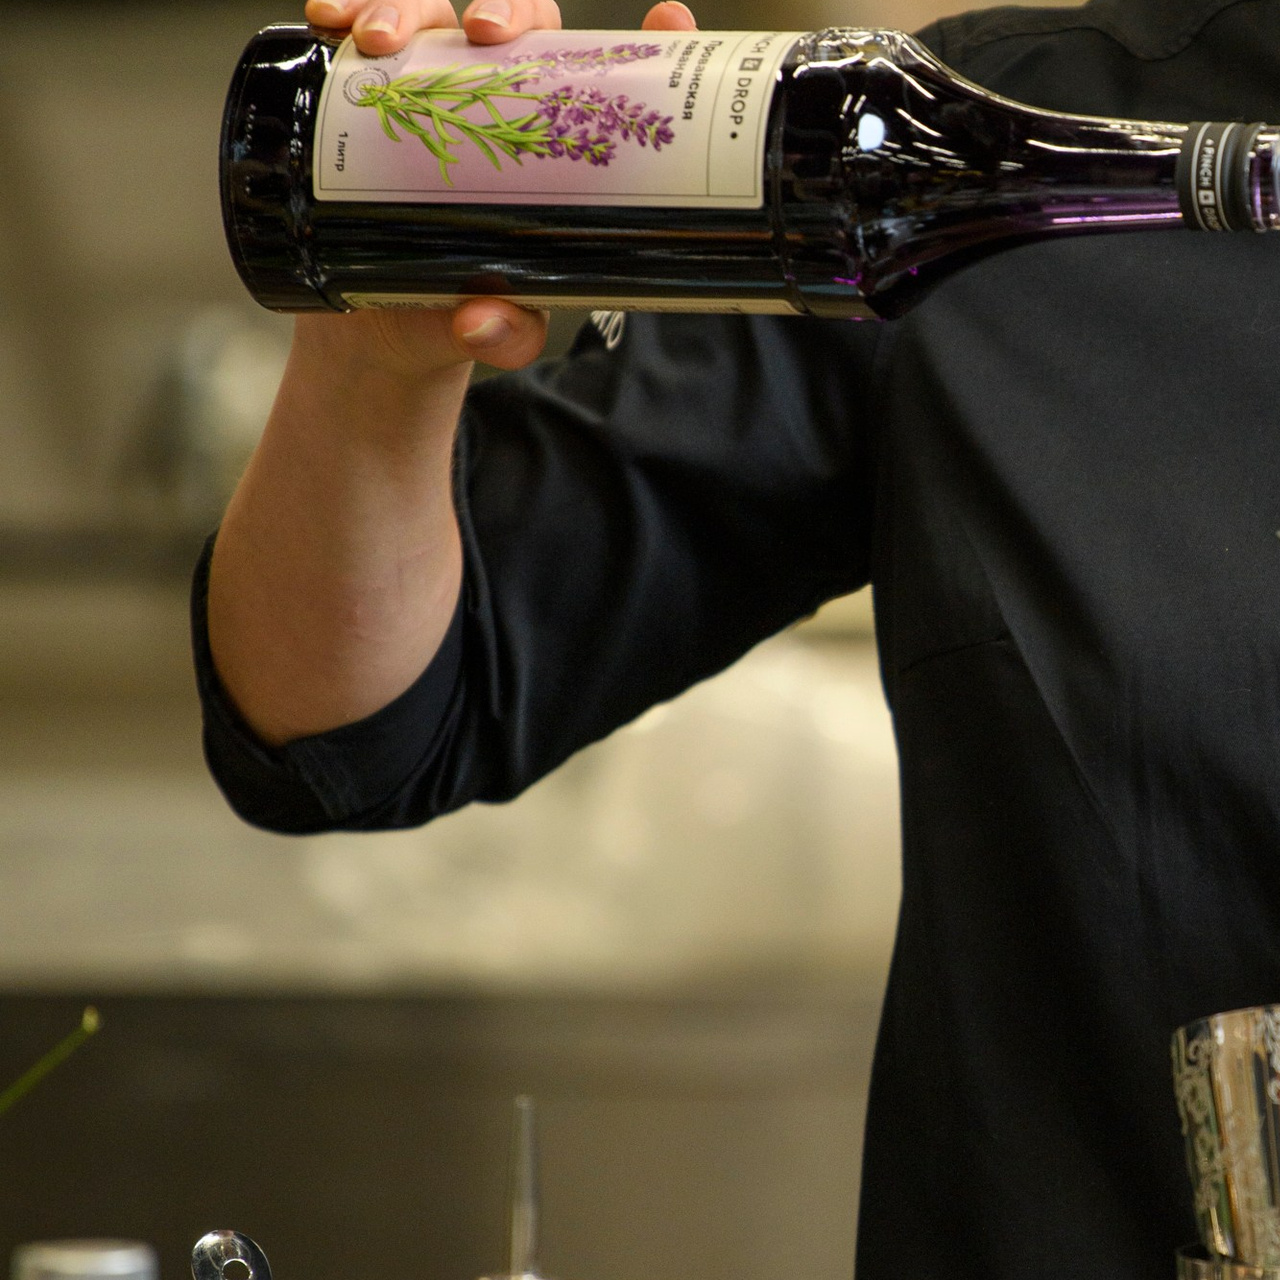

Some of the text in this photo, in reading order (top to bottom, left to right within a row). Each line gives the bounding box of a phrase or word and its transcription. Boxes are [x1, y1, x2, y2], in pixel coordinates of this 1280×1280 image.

[668, 40, 699, 88] лаванда
[682, 40, 723, 120] Прованская
[729, 77, 752, 125] DROP
[334, 141, 346, 172] литр
[1200, 147, 1215, 187] PINCH
